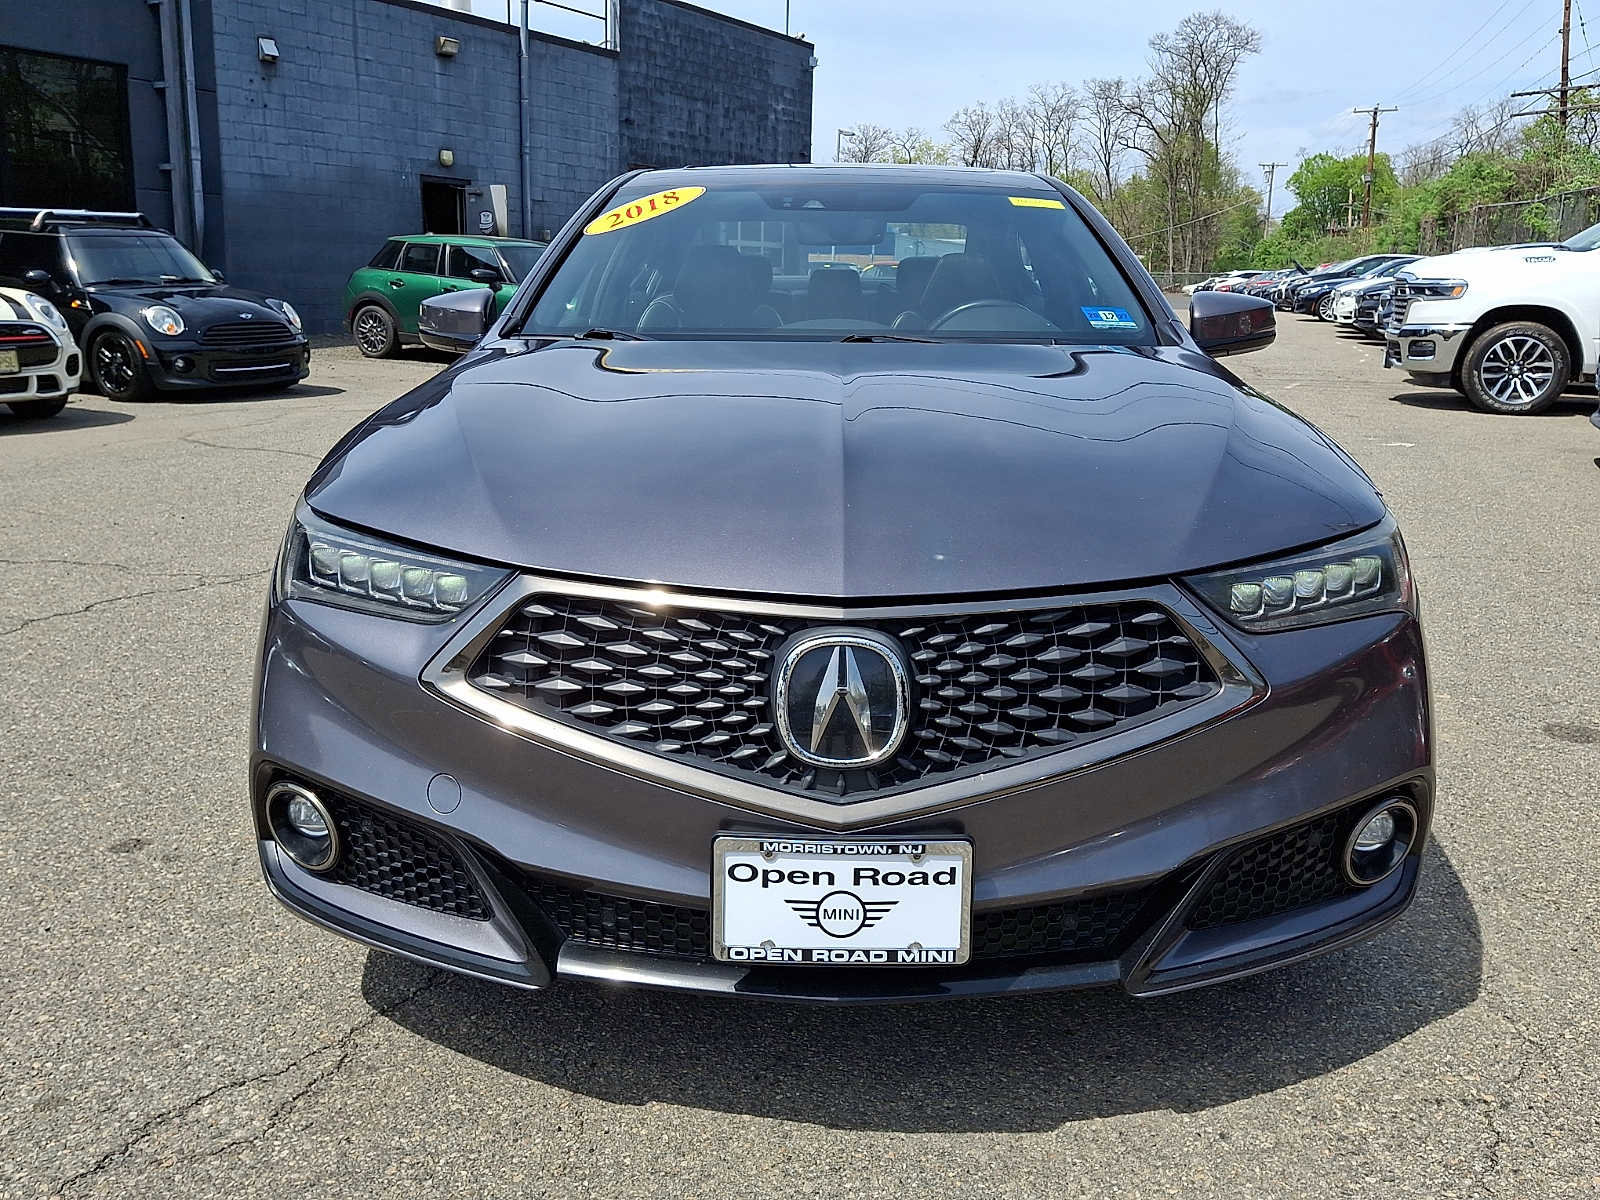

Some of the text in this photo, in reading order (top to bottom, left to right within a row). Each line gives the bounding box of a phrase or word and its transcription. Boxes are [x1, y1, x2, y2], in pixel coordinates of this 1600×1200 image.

[606, 191, 680, 229] 2018
[763, 842, 924, 856] MORRISTOWN, NJ
[727, 862, 957, 888] Open Road
[822, 908, 861, 921] MINI
[729, 947, 955, 963] OPEN ROAD MINI
